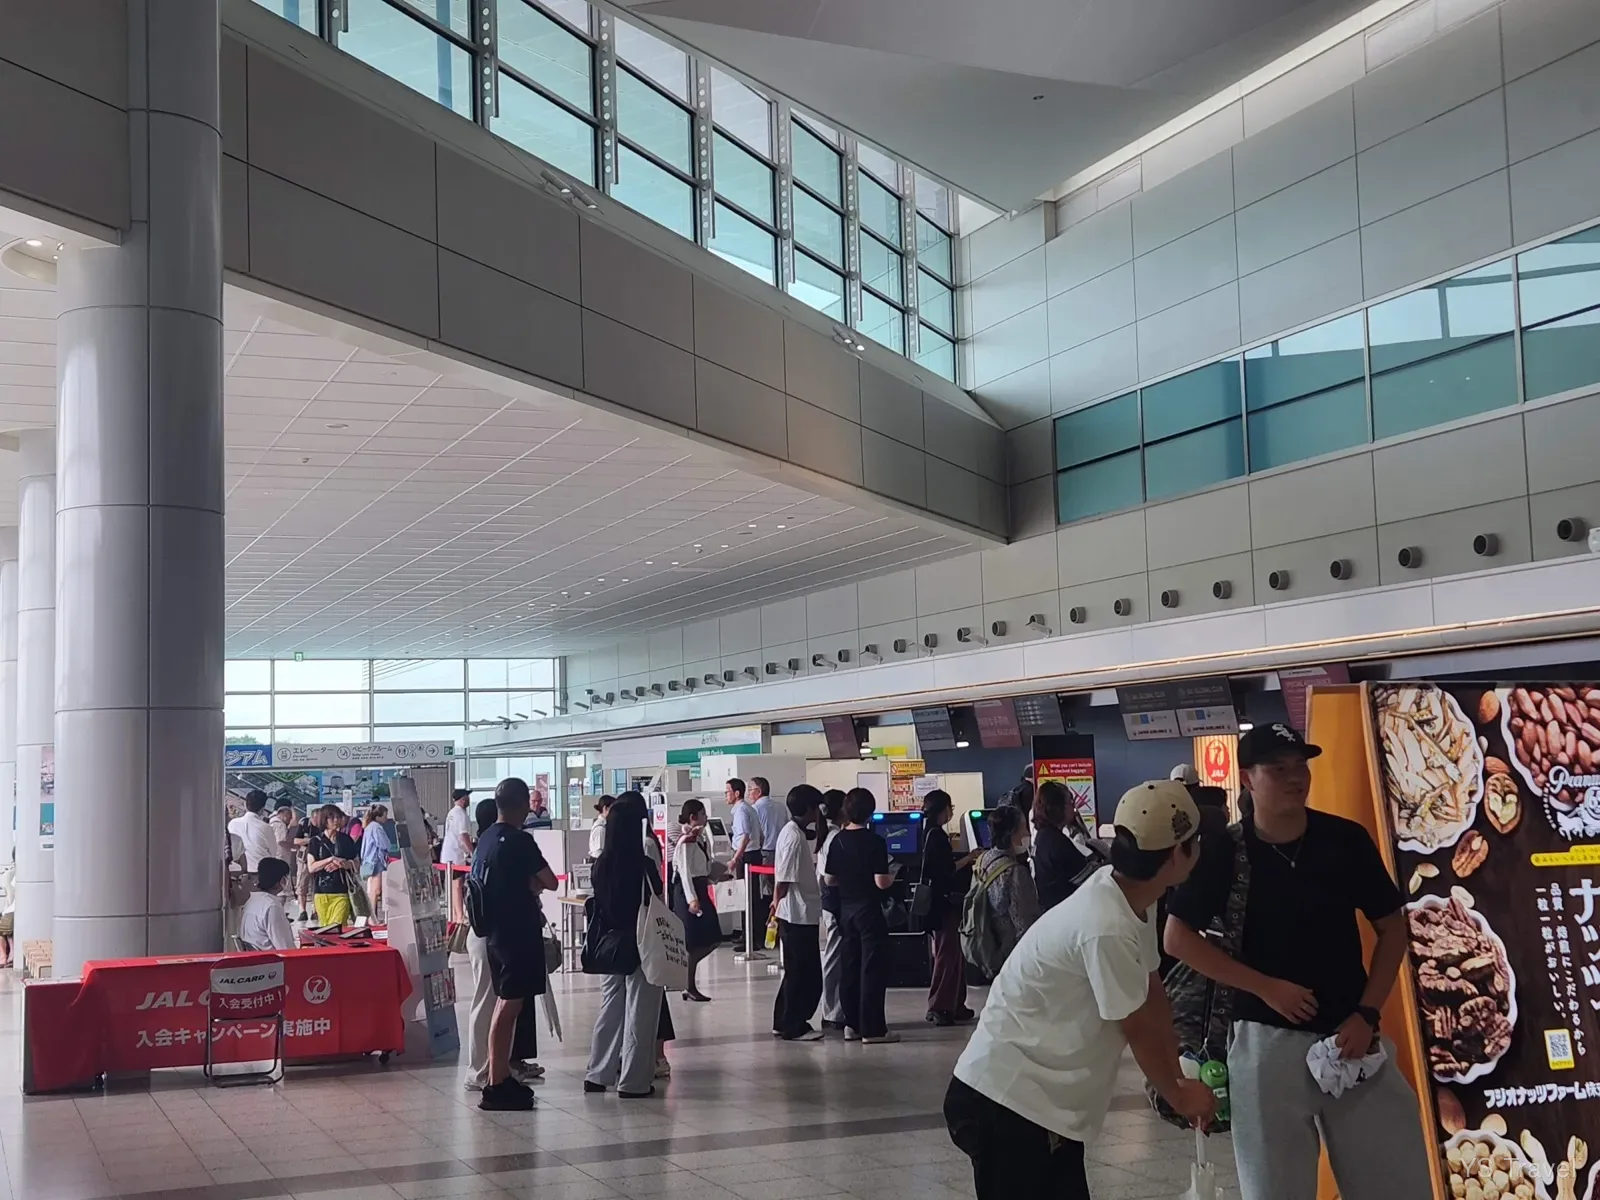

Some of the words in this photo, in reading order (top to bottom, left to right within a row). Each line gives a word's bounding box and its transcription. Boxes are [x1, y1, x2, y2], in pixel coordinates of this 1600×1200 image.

[293, 746, 334, 754] エレベーター
[1211, 769, 1225, 777] JAL
